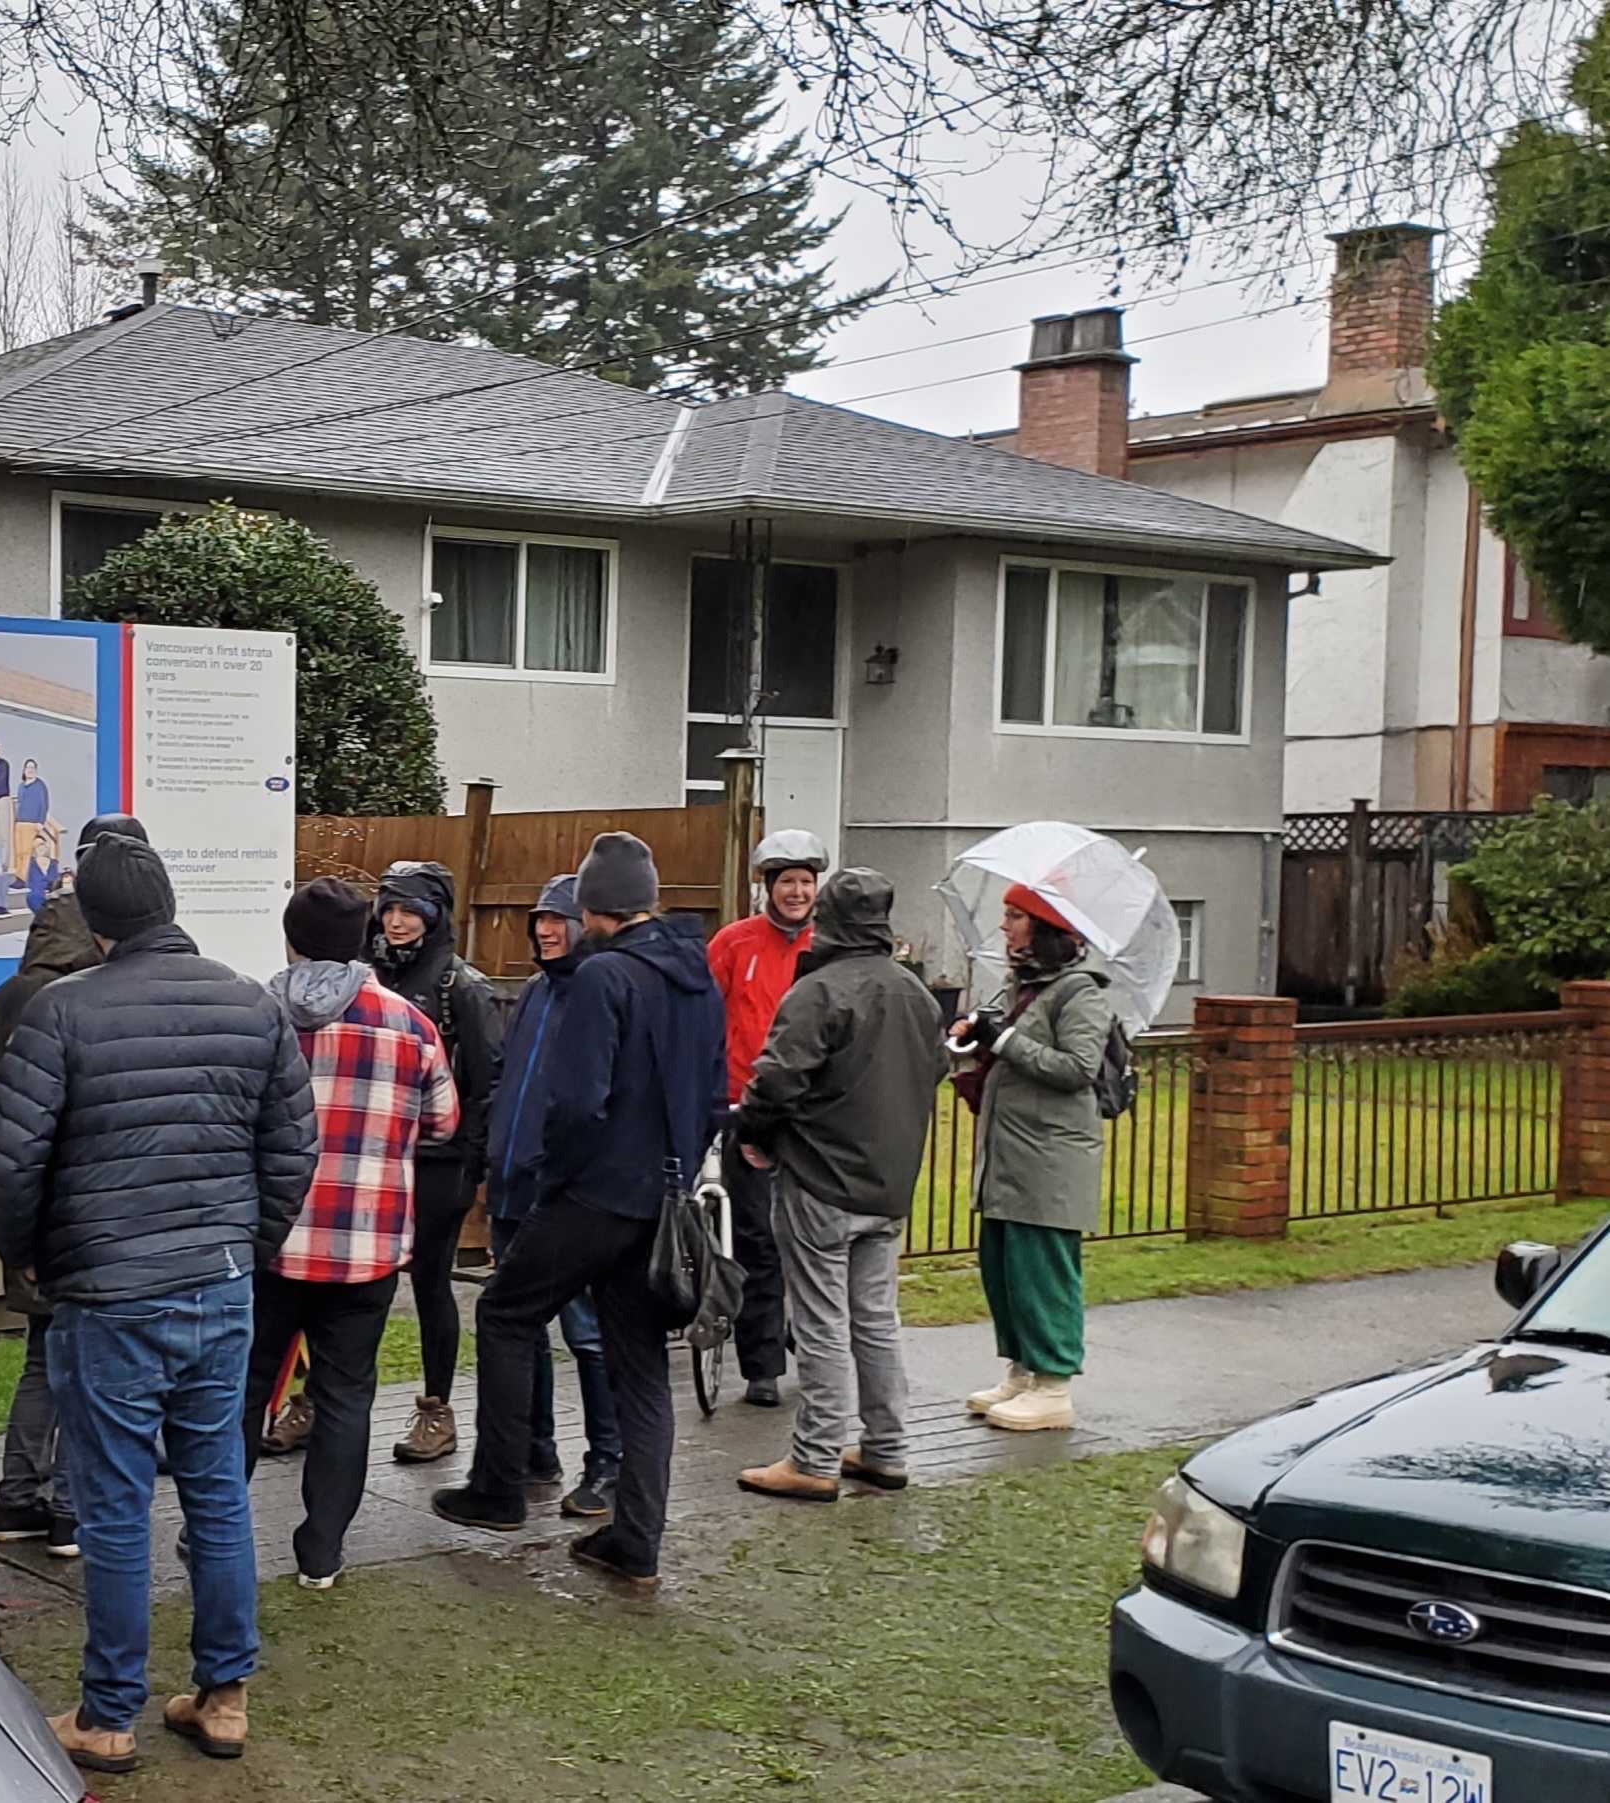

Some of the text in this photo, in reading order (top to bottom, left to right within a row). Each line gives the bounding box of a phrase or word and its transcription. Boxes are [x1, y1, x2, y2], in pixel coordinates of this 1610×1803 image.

[146, 639, 273, 658] Vancouver's first strata
[146, 657, 263, 671] conversion in over 20
[145, 671, 176, 682] years
[187, 849, 198, 859] to
[201, 848, 239, 859] defend
[241, 848, 278, 859] rentals
[1336, 1749, 1398, 1803] EV2
